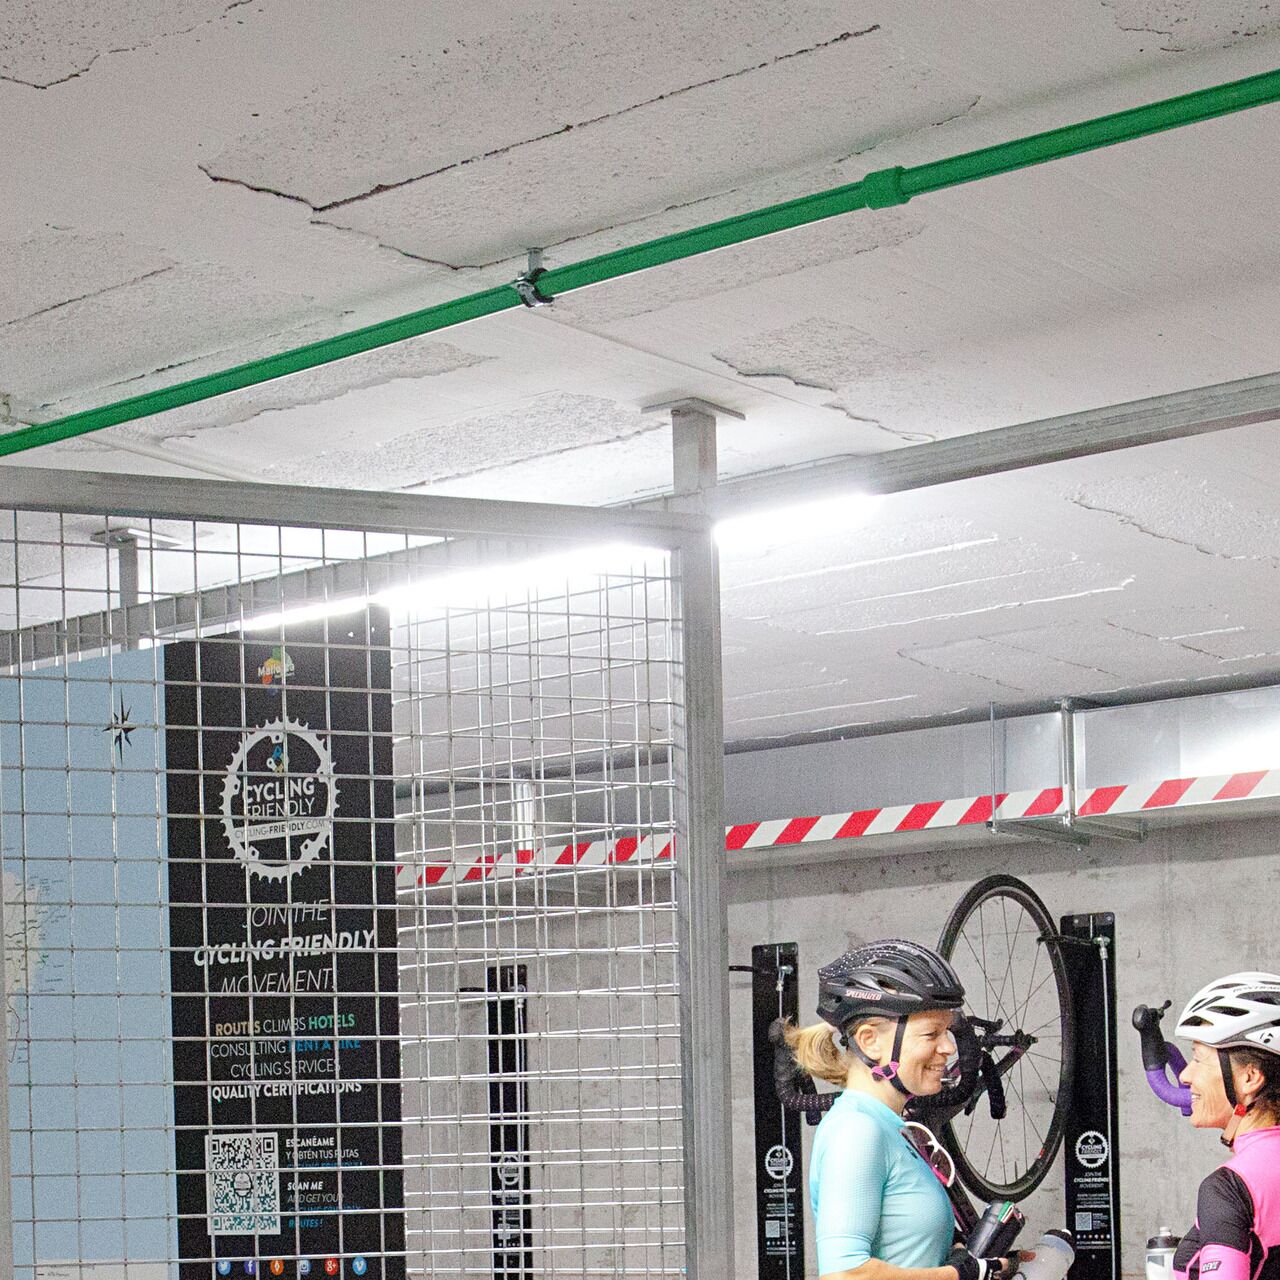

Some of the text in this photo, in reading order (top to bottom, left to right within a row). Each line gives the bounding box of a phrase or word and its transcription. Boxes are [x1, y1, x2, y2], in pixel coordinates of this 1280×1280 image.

[242, 777, 315, 803] CYCLNG
[245, 797, 315, 820] FRIENDLY
[234, 820, 325, 838] CYLING-FRIEDLY.COM
[242, 899, 330, 928] JOIN THE
[194, 929, 375, 966] CYCLING FRIENDLY
[844, 989, 882, 1000] SPECIALIZED
[263, 1017, 306, 1033] CLIMBS
[308, 1013, 356, 1029] HOTELS
[210, 1039, 287, 1057] CONSULTING
[334, 1036, 362, 1049] IKE
[230, 1061, 282, 1077] CYCLING
[212, 1082, 362, 1103] QUALITY CERTFICATIONS
[287, 1181, 324, 1191] SCAN ME
[287, 1193, 306, 1203] AD
[306, 1193, 321, 1203] GET
